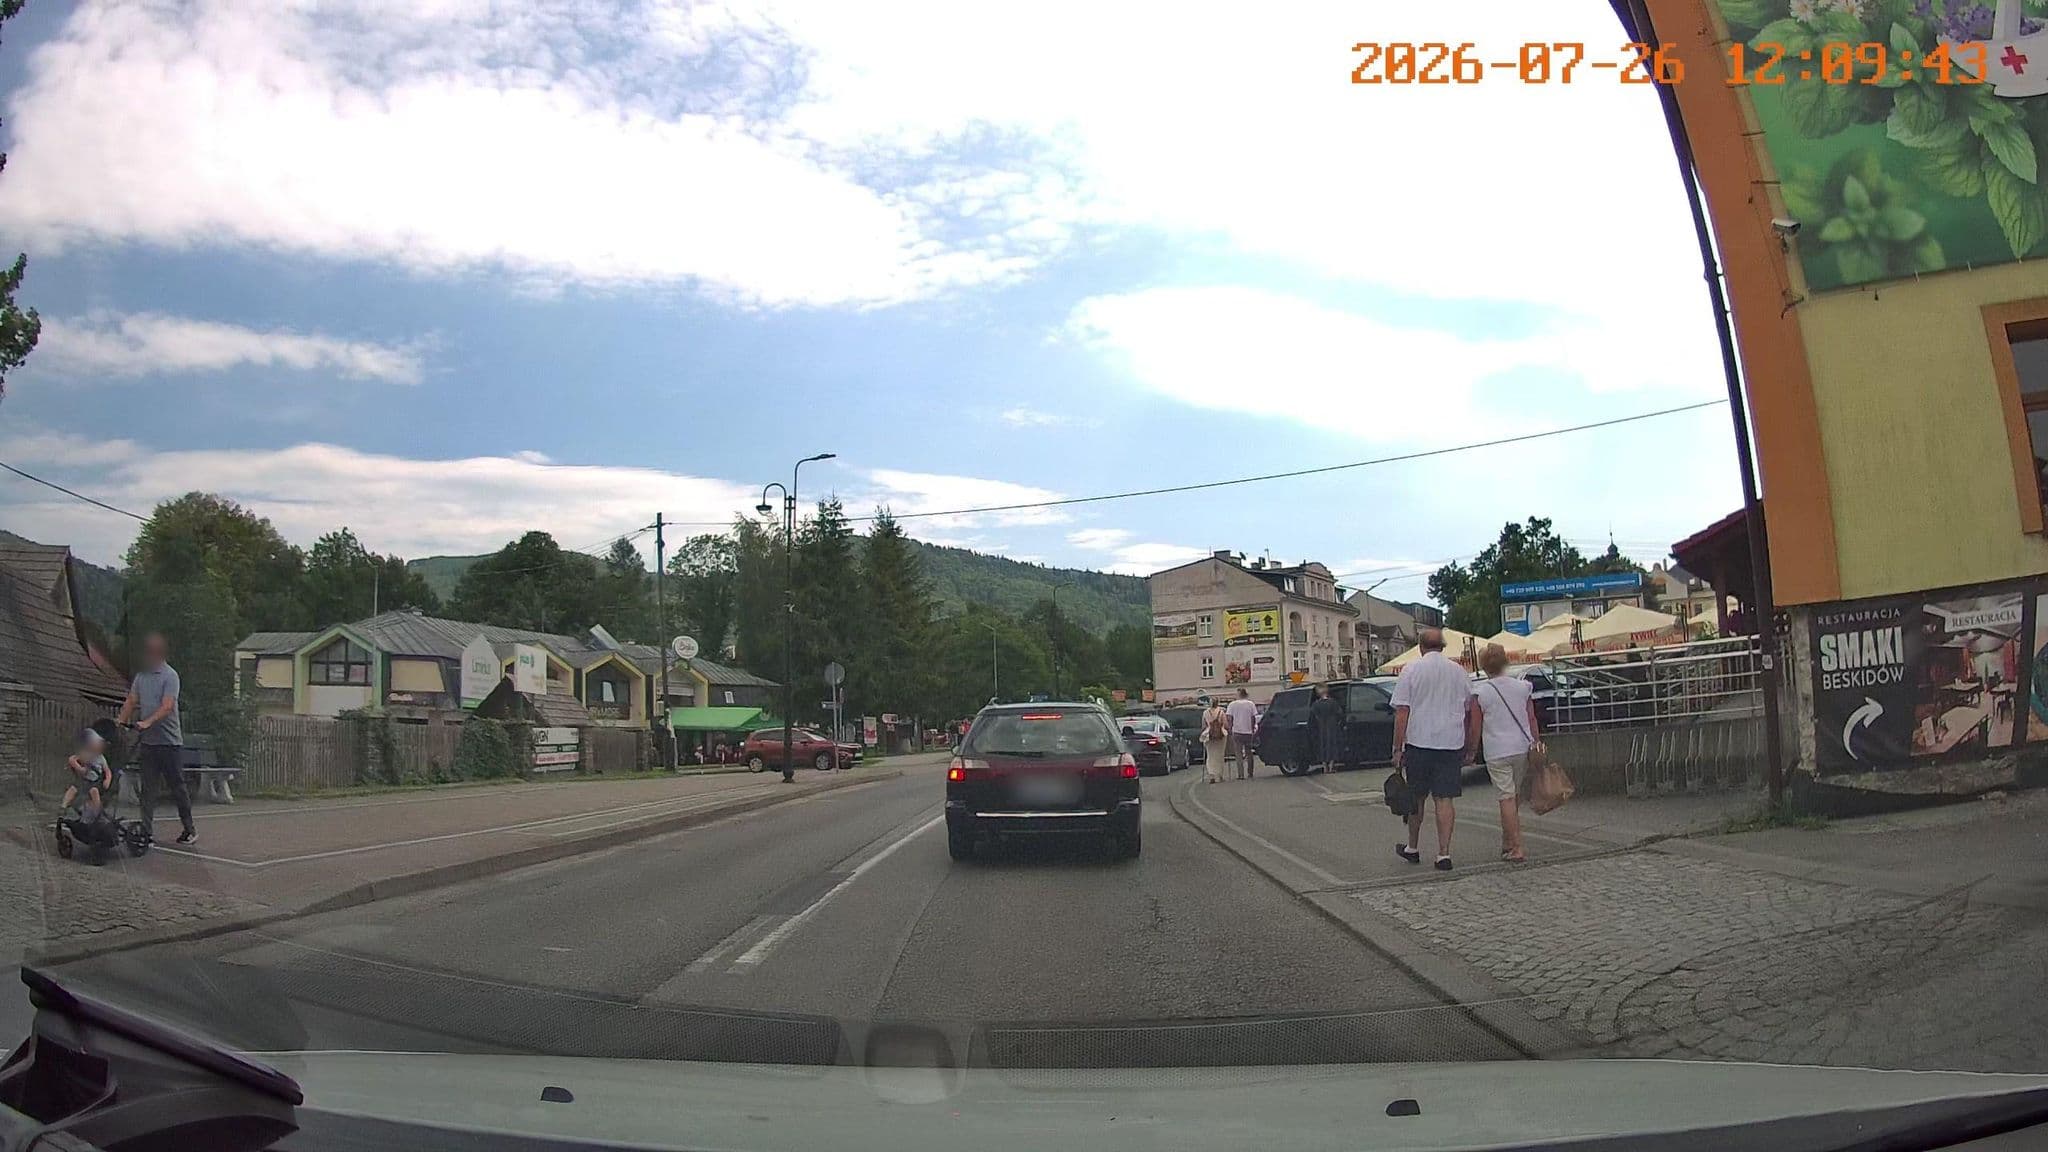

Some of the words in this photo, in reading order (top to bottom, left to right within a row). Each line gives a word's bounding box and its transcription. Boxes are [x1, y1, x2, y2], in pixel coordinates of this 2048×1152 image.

[1817, 608, 1900, 625] RESTAURACJA
[1951, 609, 2017, 628] RESTAURACJA
[1819, 626, 1904, 672] SMAKI
[1822, 667, 1904, 690] BESKIDÓW
